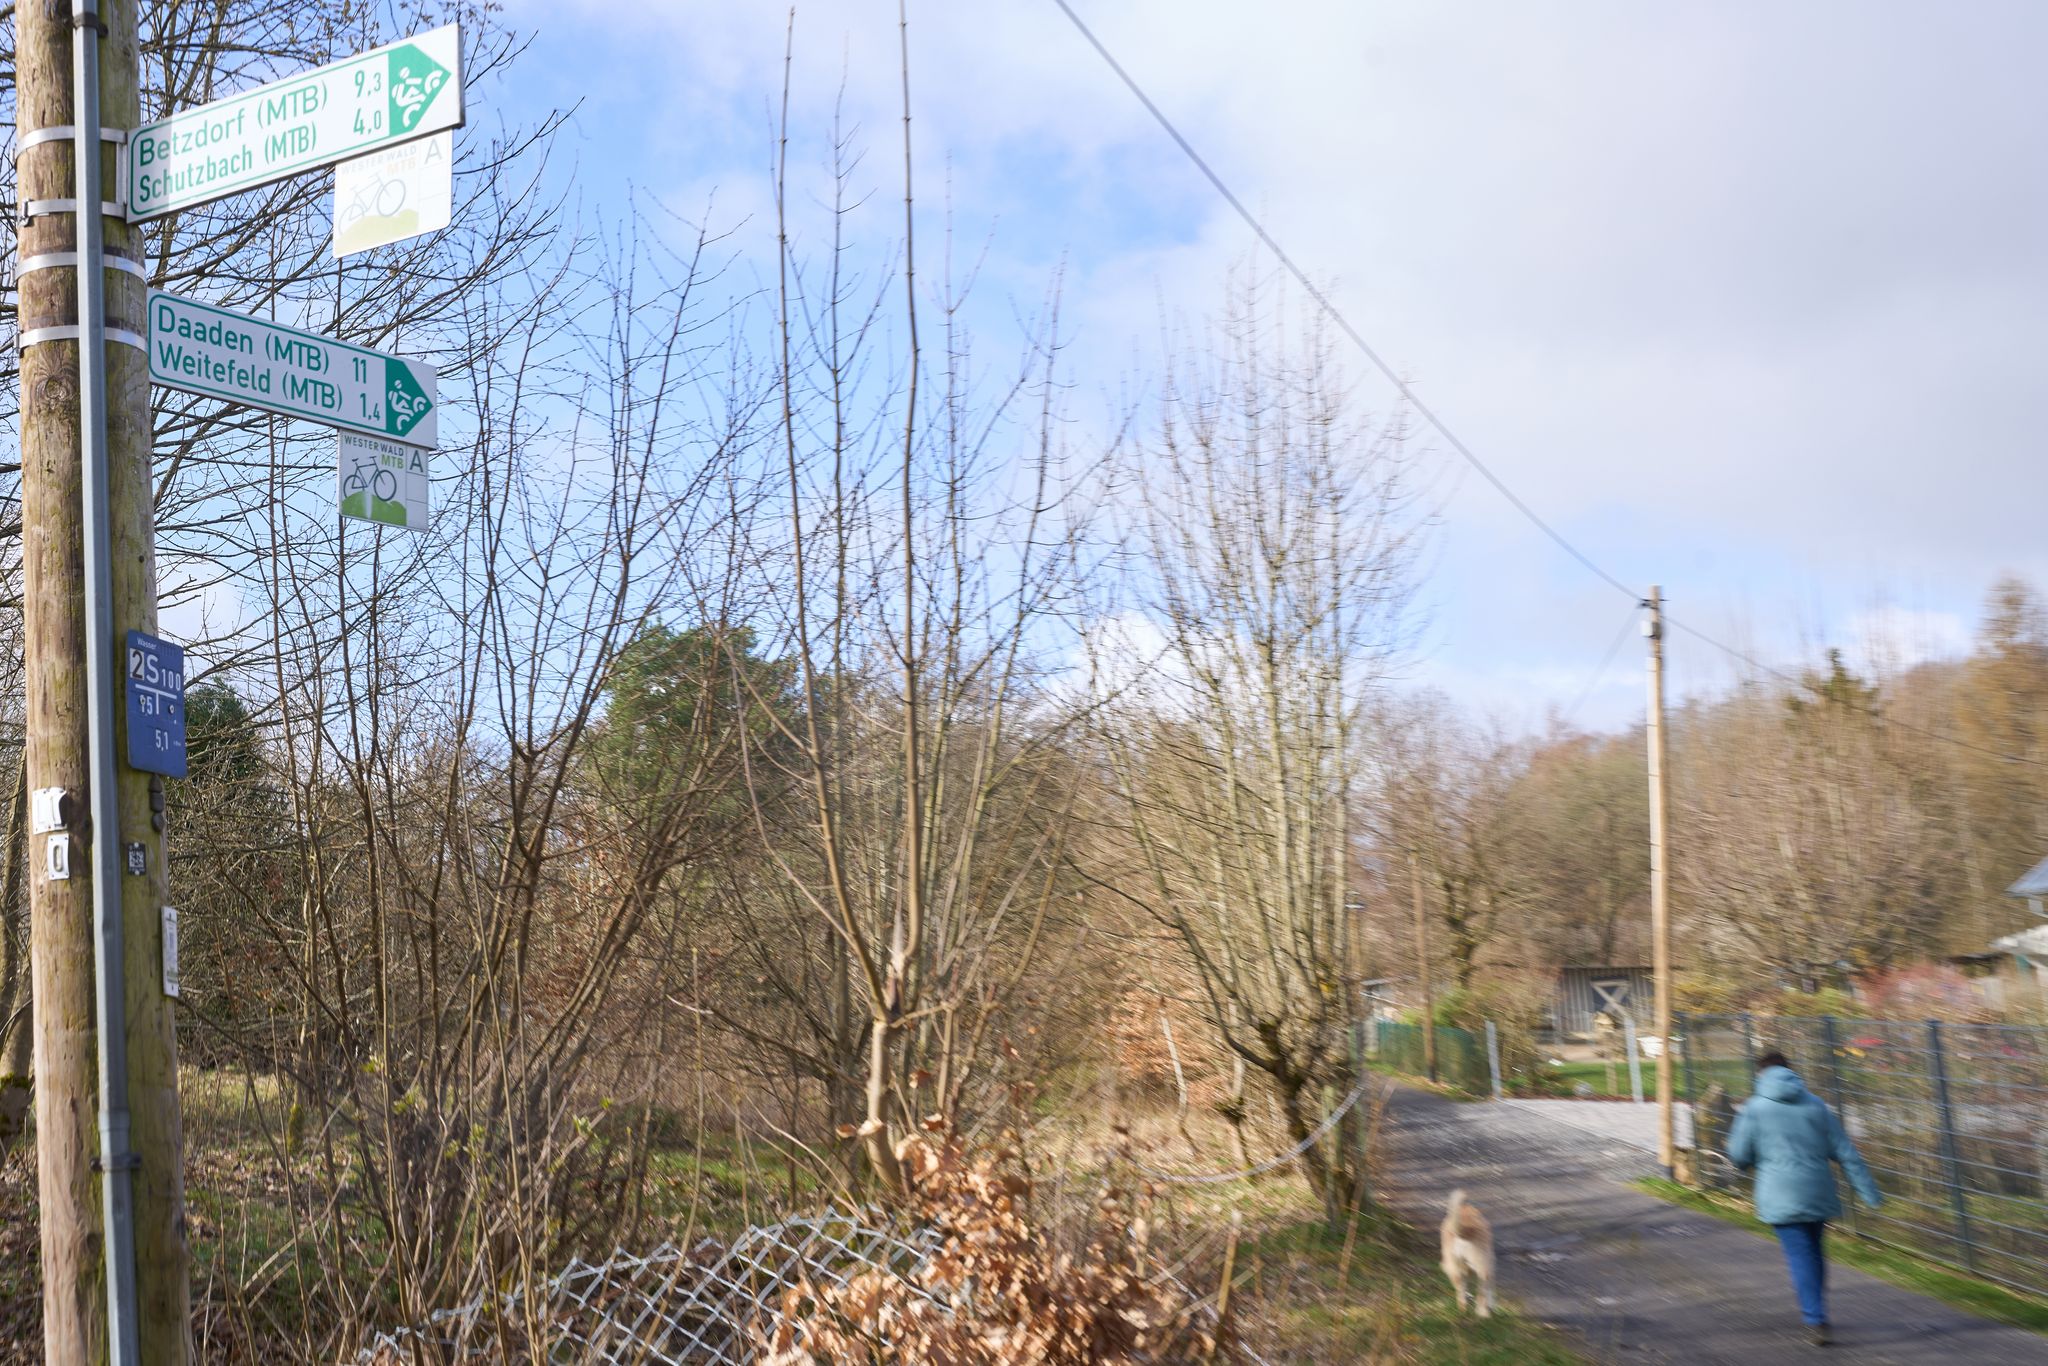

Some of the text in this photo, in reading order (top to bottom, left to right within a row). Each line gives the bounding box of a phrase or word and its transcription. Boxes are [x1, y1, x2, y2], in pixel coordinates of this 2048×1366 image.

[139, 69, 382, 168] Betzdorf (MTB) 9,3
[139, 107, 382, 203] Schutzbach (MTB) 4,0
[424, 137, 443, 165] A
[157, 340, 381, 422] Weitefeld (MTB) 1,4
[158, 304, 367, 384] Daaden (MTB) 11
[381, 453, 404, 469] MTB
[409, 449, 424, 473] A
